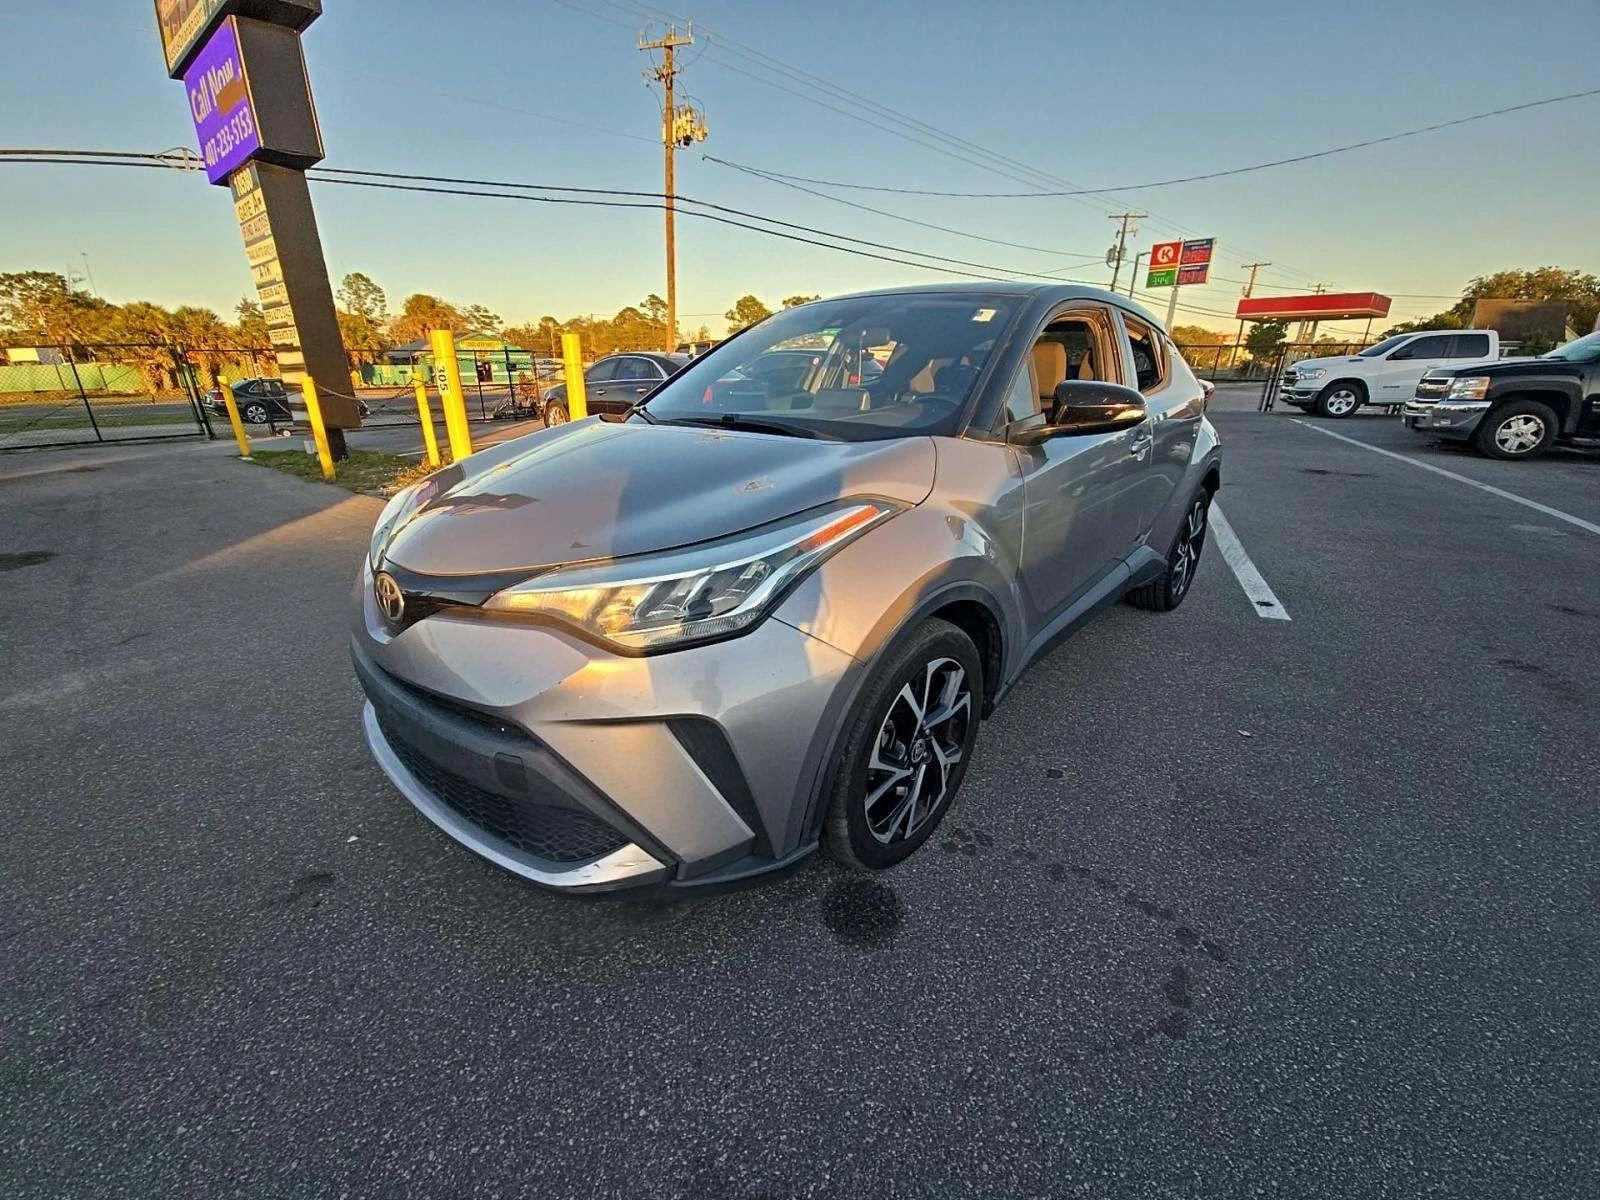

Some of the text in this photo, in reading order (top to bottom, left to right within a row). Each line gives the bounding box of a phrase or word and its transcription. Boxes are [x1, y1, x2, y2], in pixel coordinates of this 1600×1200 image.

[190, 58, 234, 124] Call Now
[205, 106, 253, 166] 407-233-5153
[1160, 247, 1173, 263] K
[437, 365, 448, 391] 305
